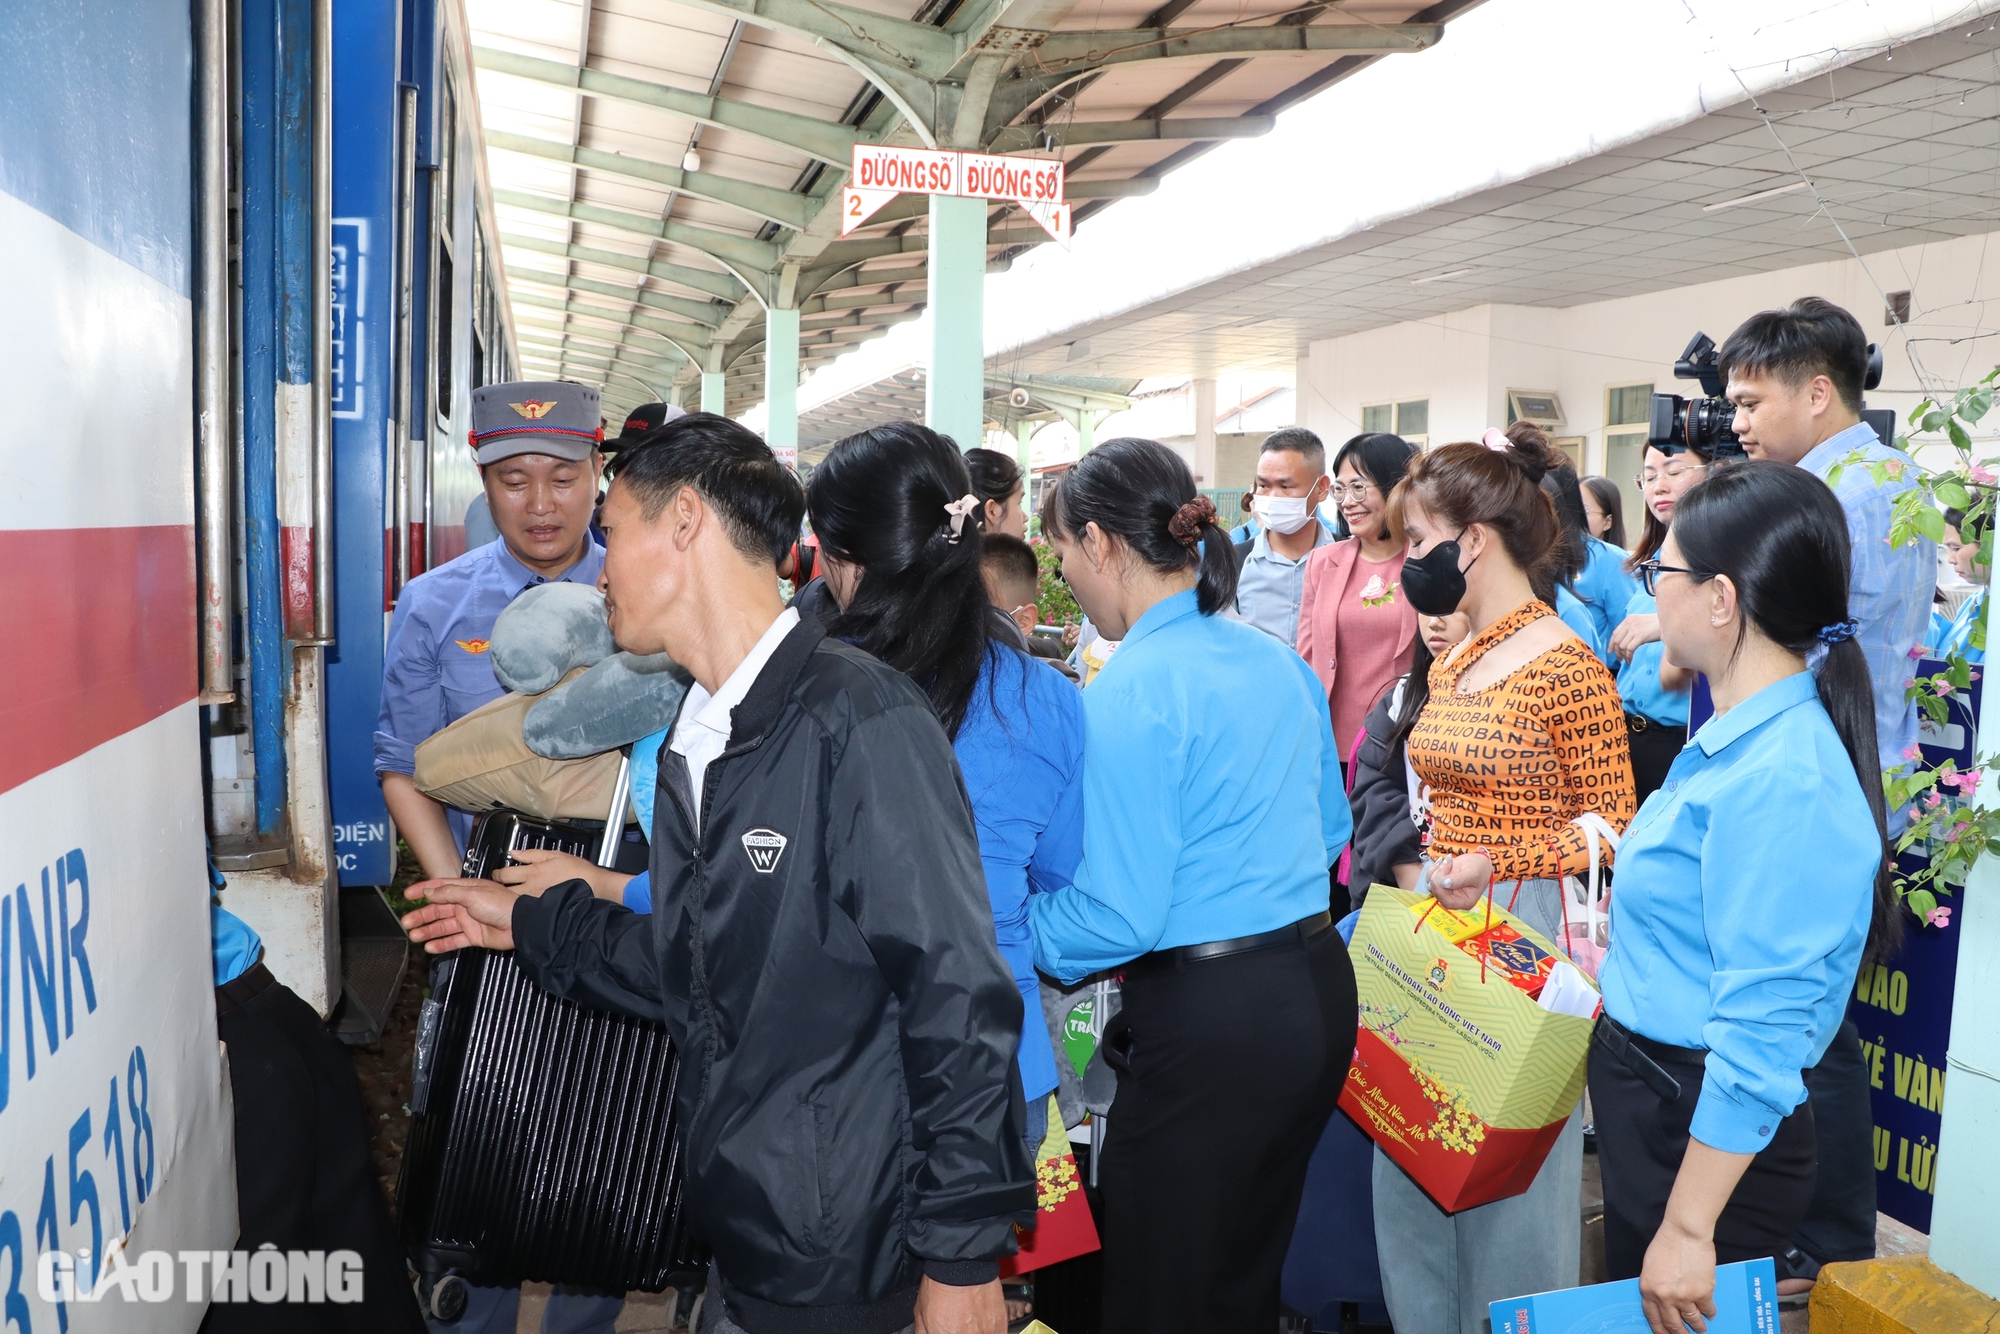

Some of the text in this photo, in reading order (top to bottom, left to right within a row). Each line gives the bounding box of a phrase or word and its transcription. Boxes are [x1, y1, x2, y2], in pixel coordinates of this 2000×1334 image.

[928, 157, 954, 191] SỐ
[1035, 165, 1060, 199] SỐ
[849, 195, 862, 216] 2
[1051, 211, 1060, 231] 1
[1442, 711, 1505, 724] HUOBAN
[1443, 725, 1523, 745] HUOBAN
[1425, 755, 1496, 776] HUOBAN
[746, 837, 781, 845] FASHION
[753, 849, 774, 867] W
[0, 848, 97, 1113] NR
[1423, 990, 1438, 1006] LAO
[1480, 1032, 1502, 1052] NAM
[1348, 1067, 1368, 1087] Chúc
[1388, 1104, 1407, 1125] Năm
[1361, 1094, 1406, 1137] HAPPY NEW YEAR
